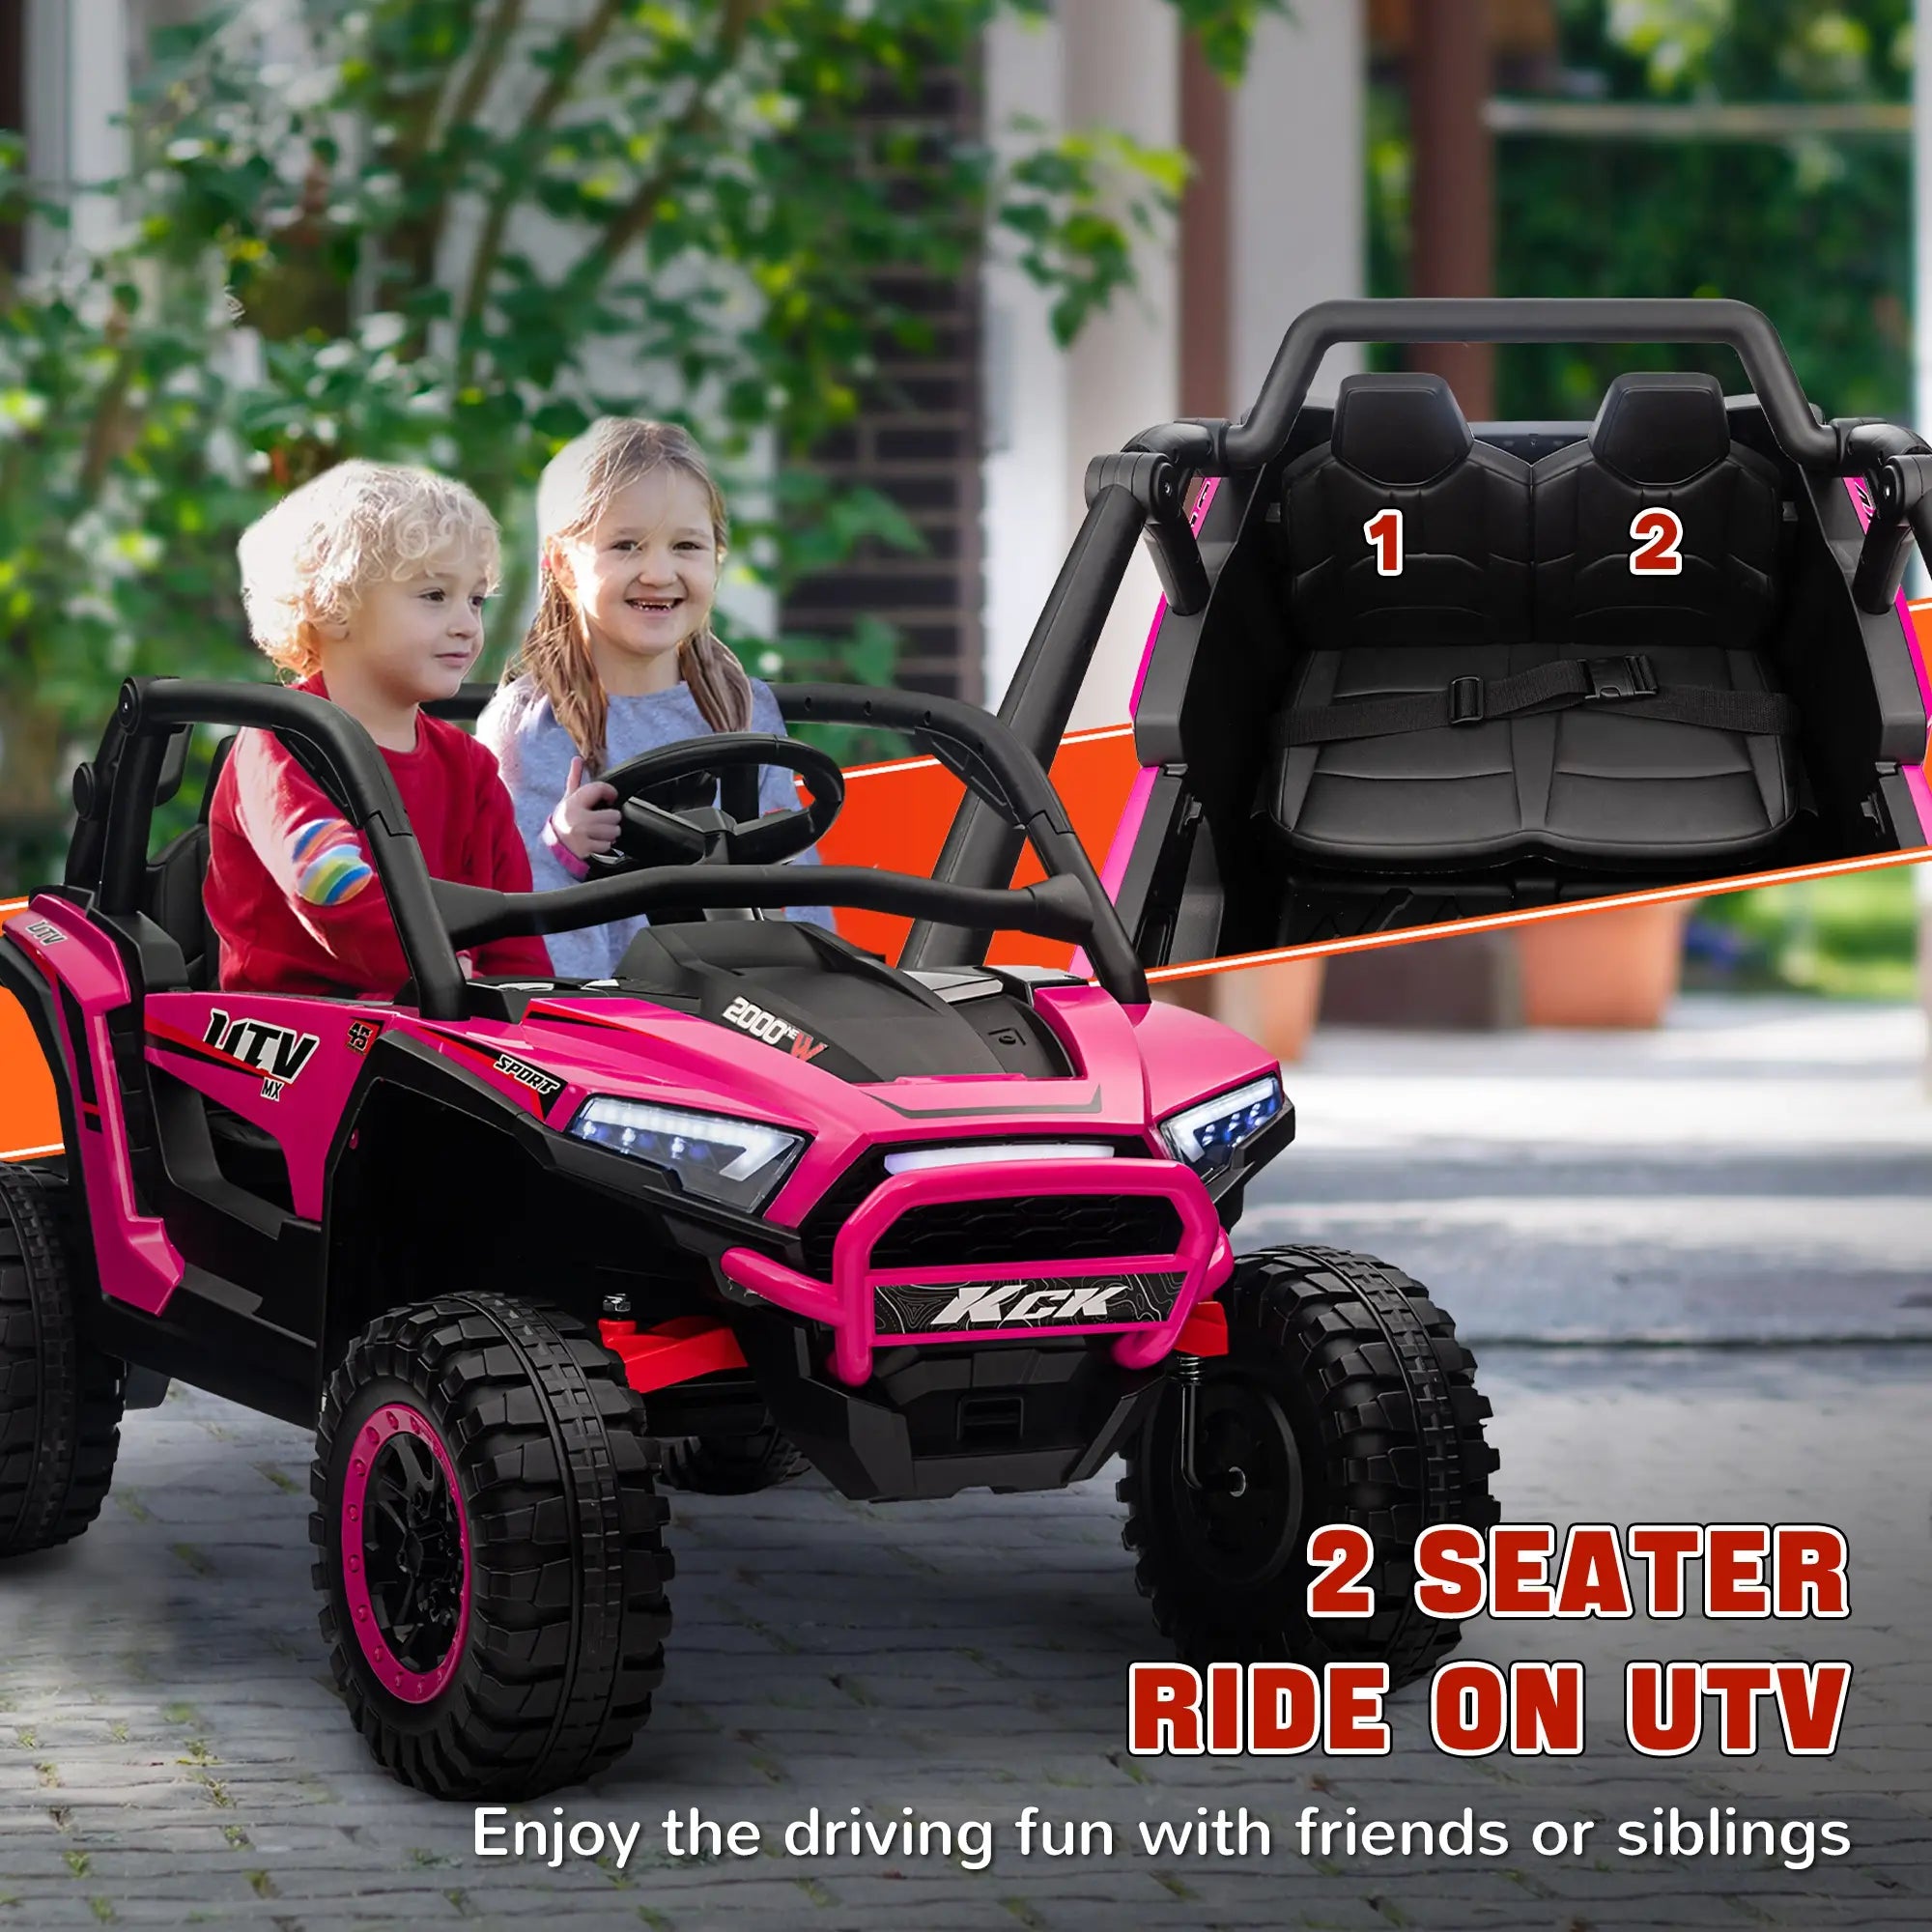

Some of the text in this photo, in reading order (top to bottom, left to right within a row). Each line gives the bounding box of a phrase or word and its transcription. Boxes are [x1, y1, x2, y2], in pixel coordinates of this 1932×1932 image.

[25, 919, 69, 947] UTV
[493, 1053, 561, 1094] SPORT
[260, 1076, 285, 1102] MX
